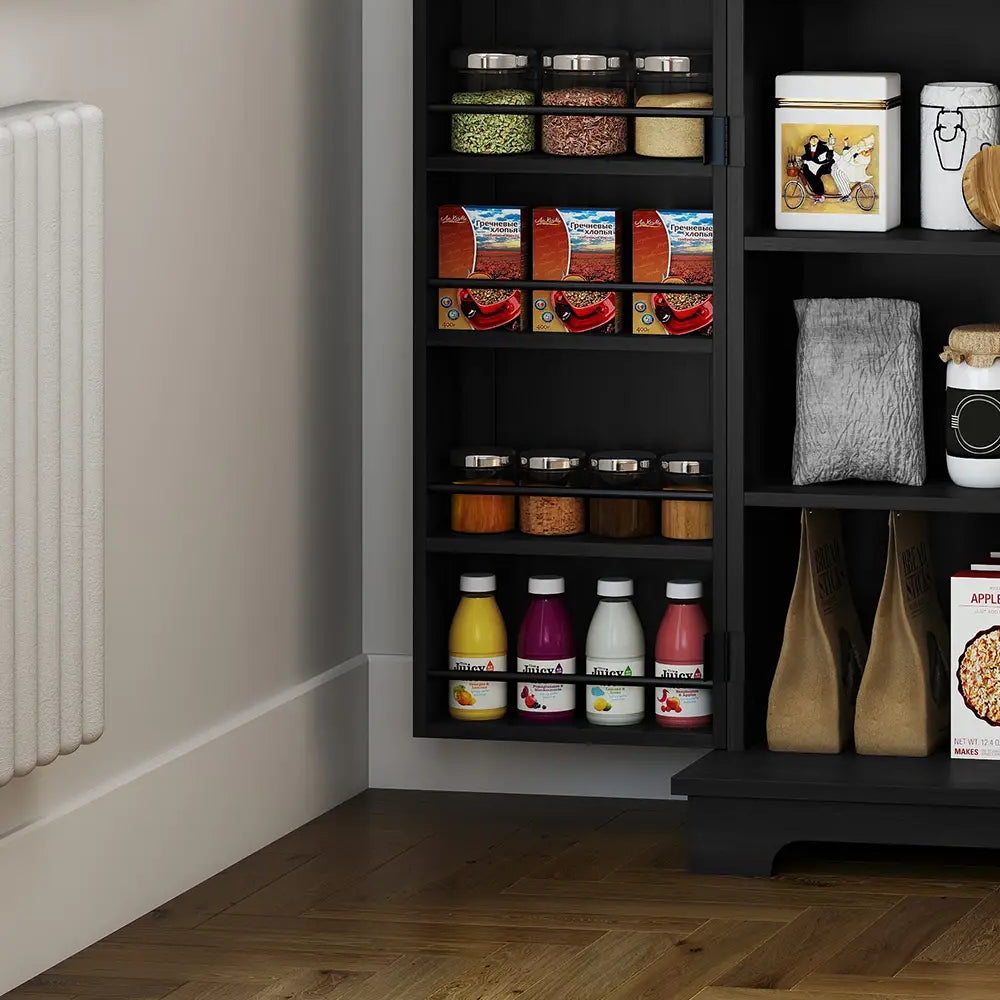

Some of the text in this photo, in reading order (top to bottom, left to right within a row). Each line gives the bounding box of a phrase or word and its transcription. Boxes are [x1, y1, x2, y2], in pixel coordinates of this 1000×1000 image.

[454, 662, 486, 671] Juicy
[523, 665, 554, 673] Juicy
[592, 667, 624, 676] Juicy
[661, 670, 693, 678] Juicy
